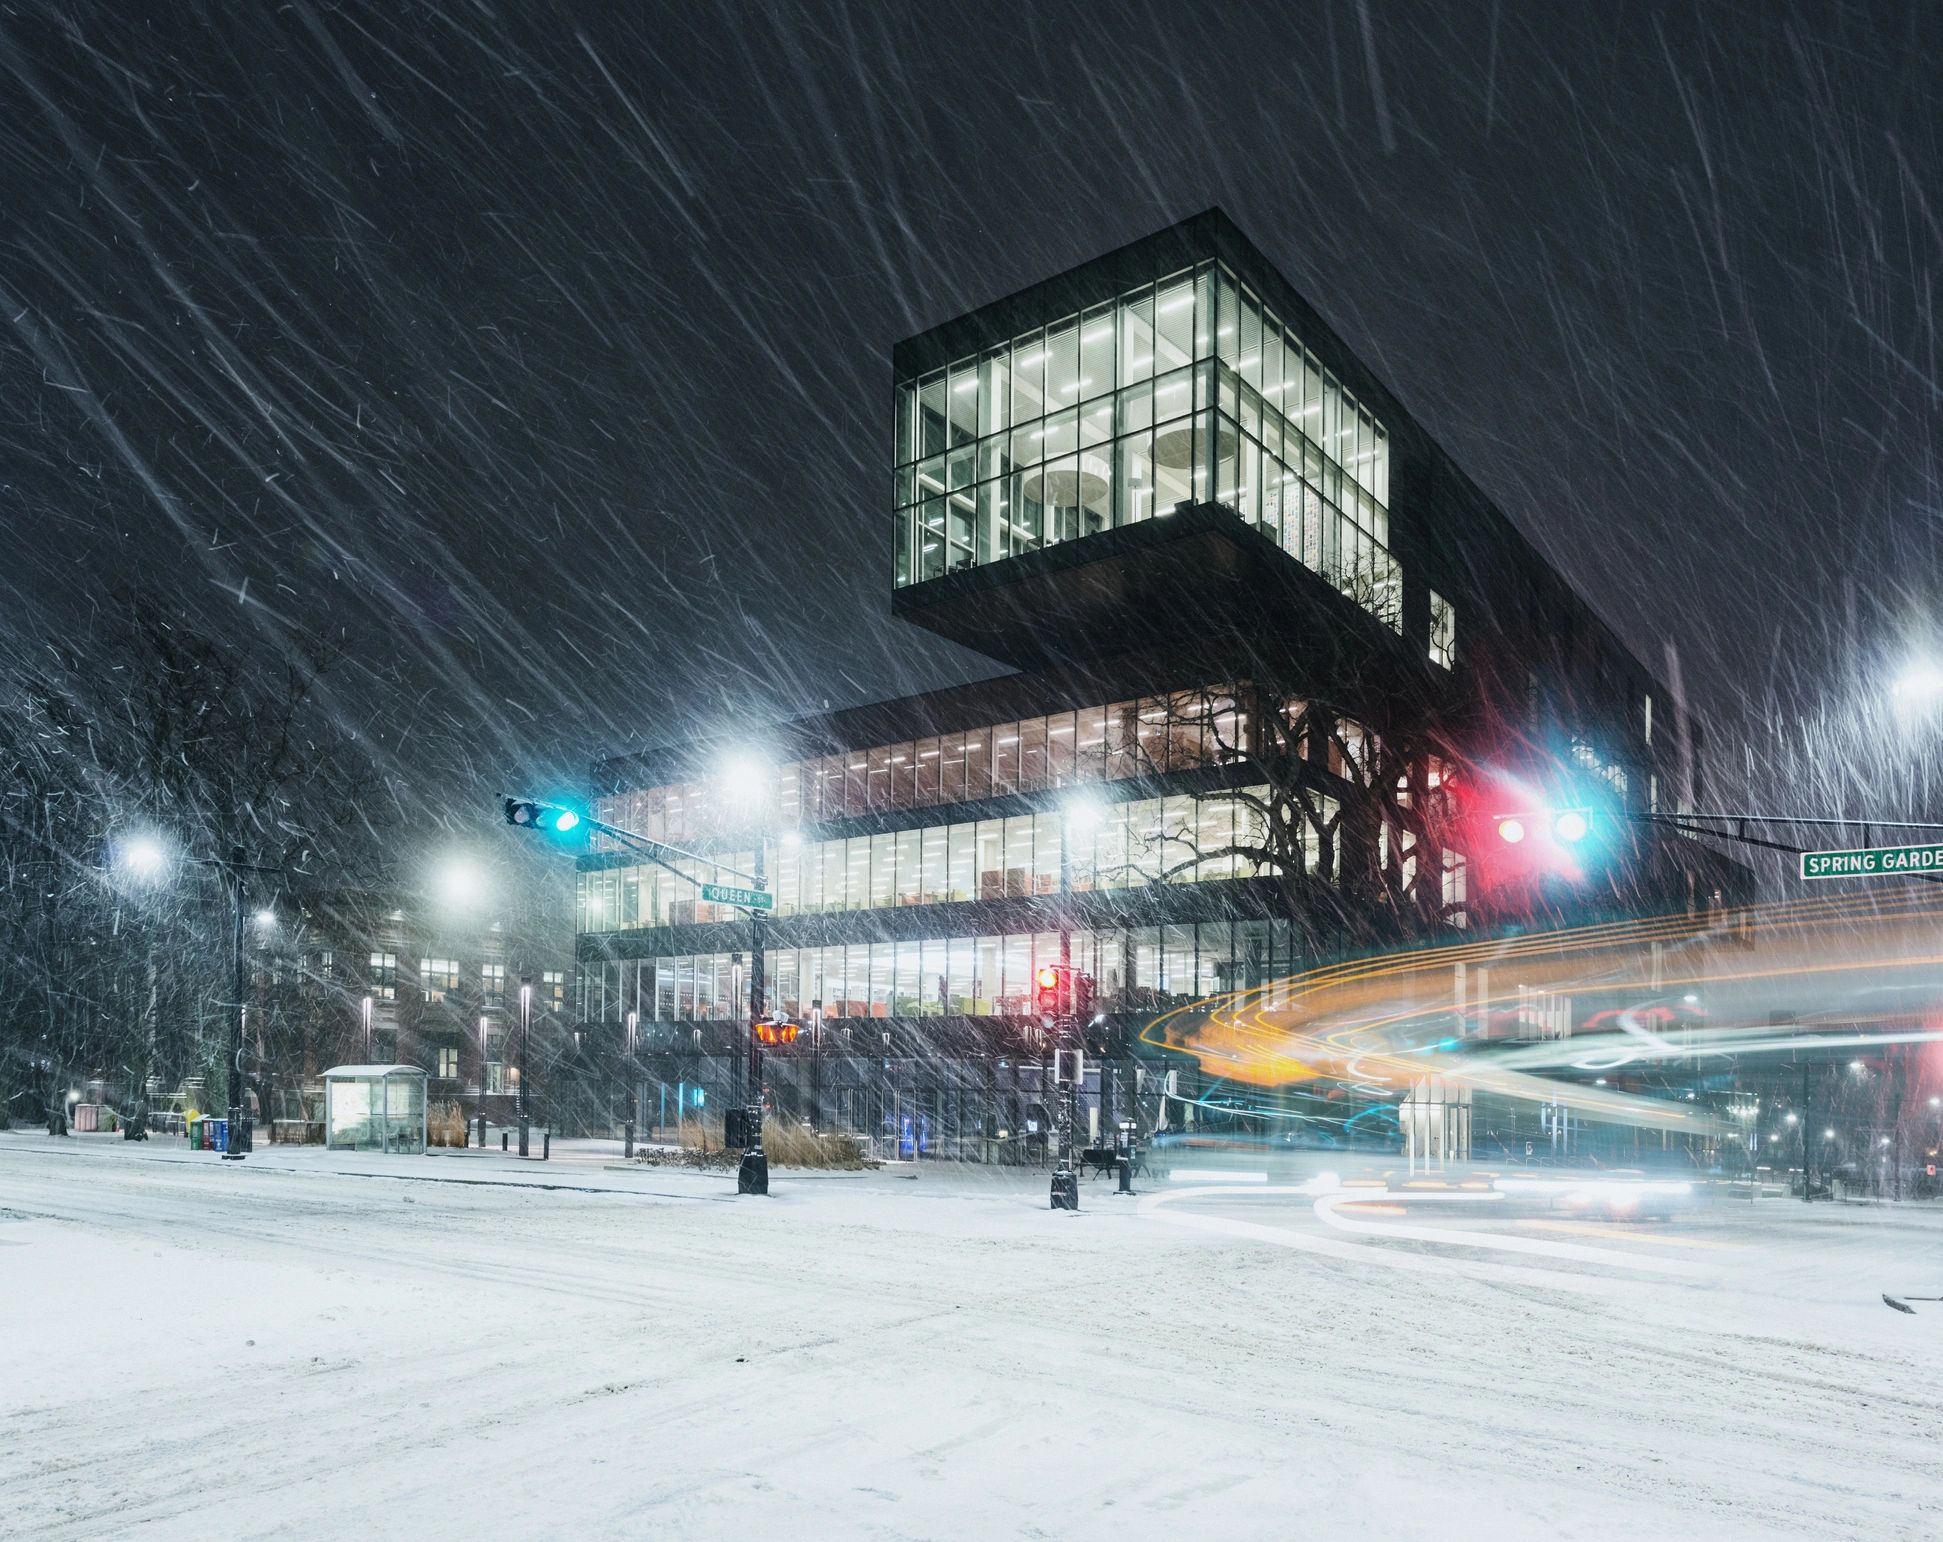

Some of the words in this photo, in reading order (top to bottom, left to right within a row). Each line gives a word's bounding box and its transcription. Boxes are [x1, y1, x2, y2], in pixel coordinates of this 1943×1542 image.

[1809, 854, 1875, 873] SPRING
[1882, 850, 1943, 869] GARDE
[711, 887, 751, 903] QUEEN
